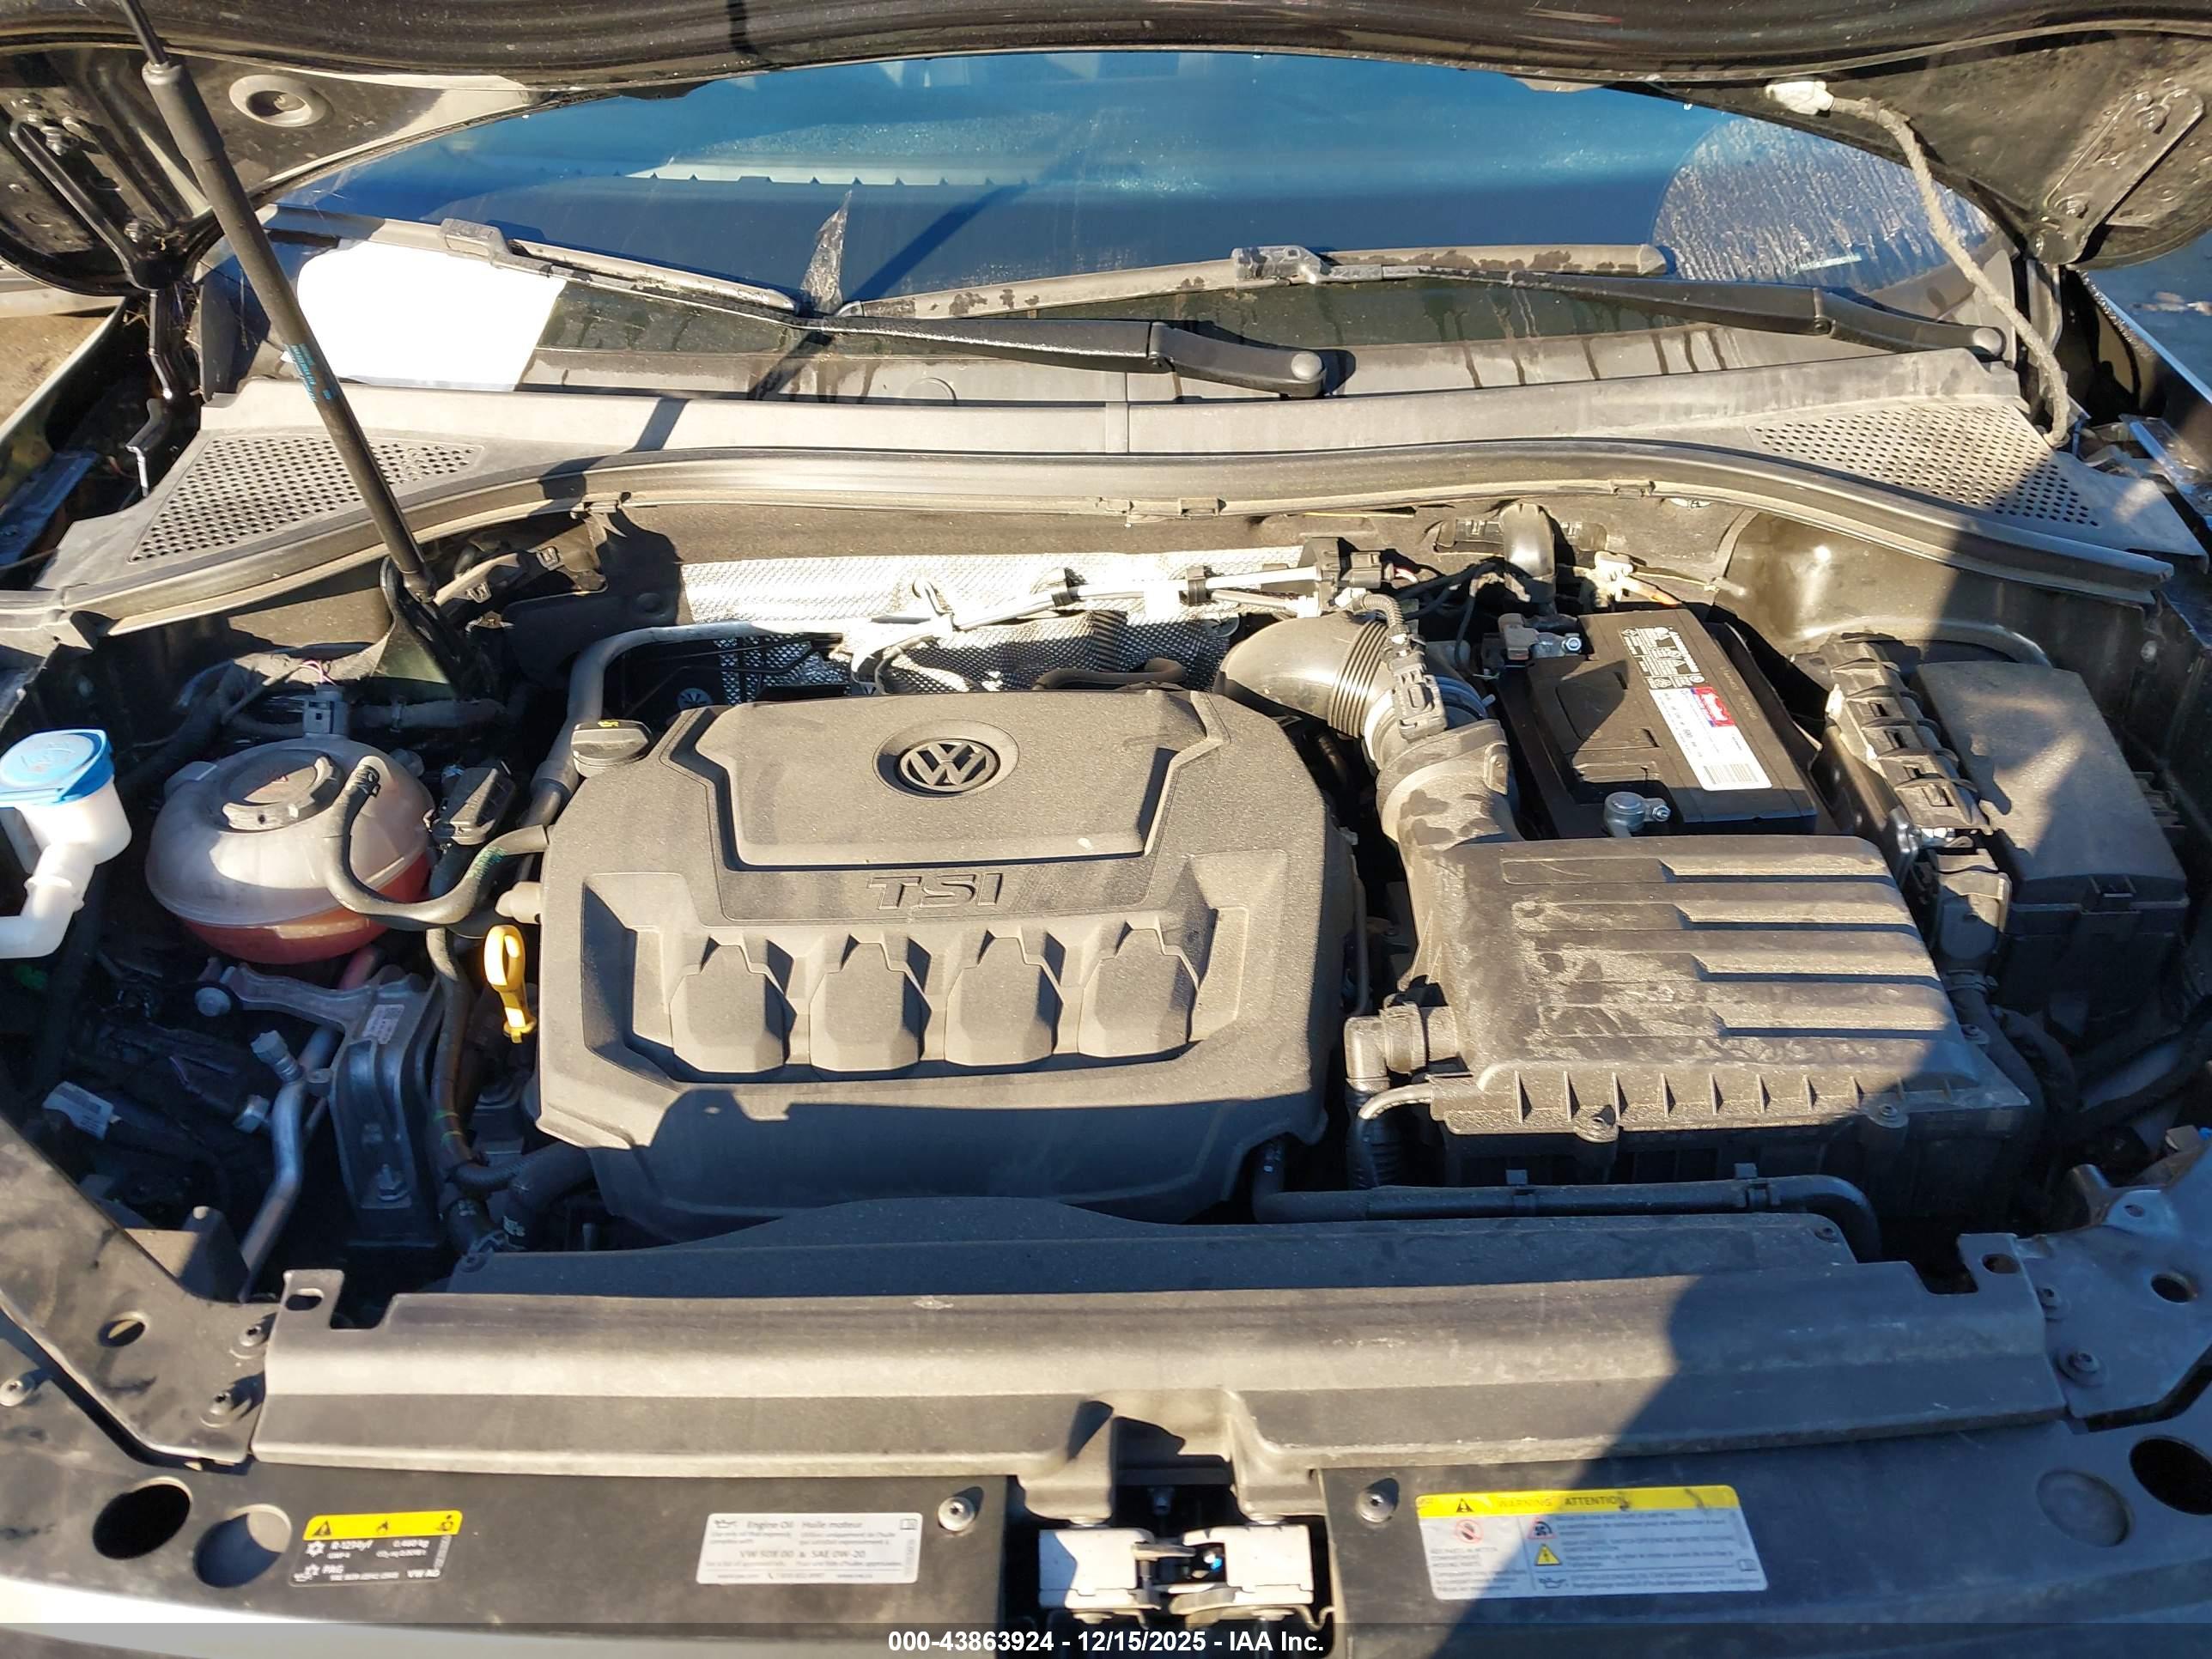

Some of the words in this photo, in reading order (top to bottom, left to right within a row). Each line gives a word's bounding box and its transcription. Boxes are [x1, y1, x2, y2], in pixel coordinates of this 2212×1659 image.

[867, 872, 1004, 910] TSI
[1498, 1498, 1553, 1507] WARNING
[1565, 1495, 1626, 1506] ATTENTION
[746, 1520, 778, 1531] Engine
[780, 1520, 794, 1528] Oil
[801, 1520, 826, 1528] Huile
